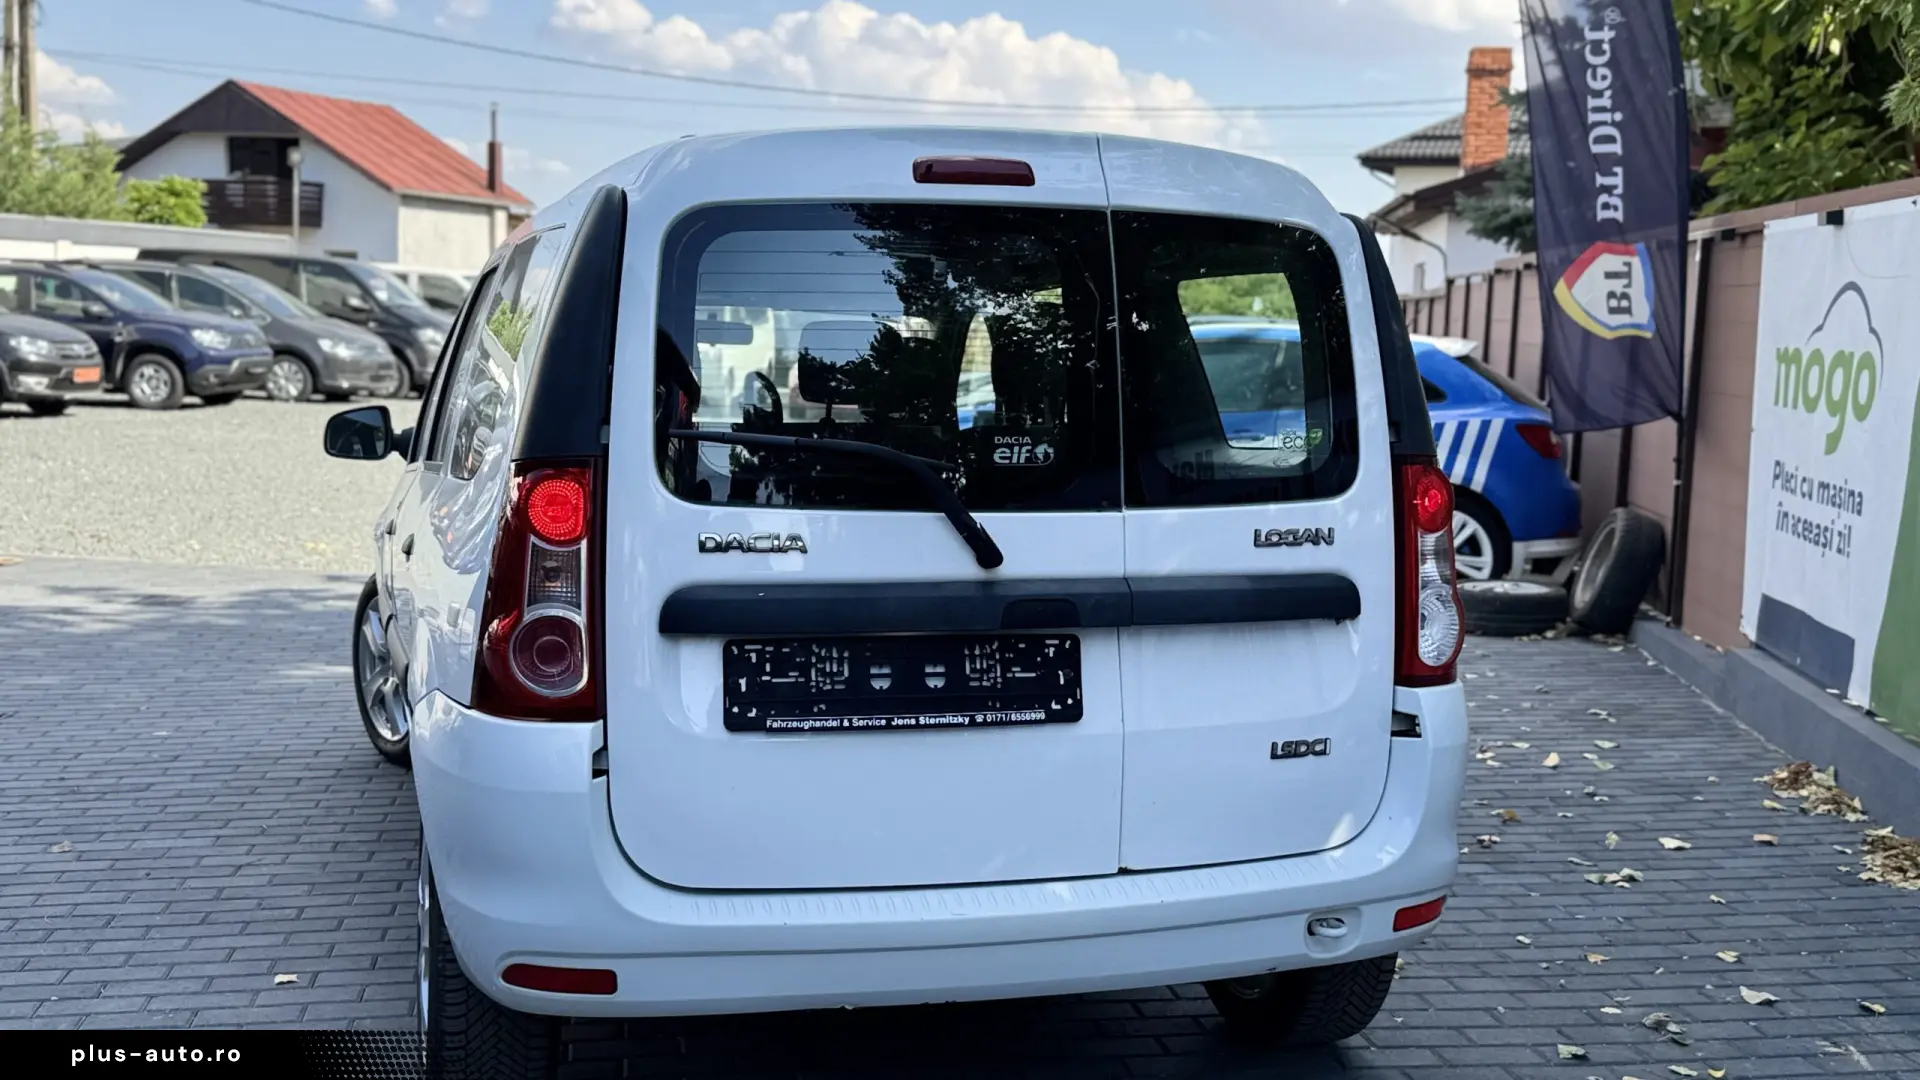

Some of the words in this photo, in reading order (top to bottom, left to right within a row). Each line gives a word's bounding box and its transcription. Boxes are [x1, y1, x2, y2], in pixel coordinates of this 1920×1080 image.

[1773, 346, 1877, 456] mogo
[994, 436, 1032, 444] DACIA
[993, 445, 1033, 464] elf
[1771, 459, 1799, 497] Pleci
[1800, 475, 1814, 502] cu
[1816, 478, 1864, 519] mașina
[1253, 527, 1335, 548] LOGAN
[1775, 500, 1790, 534] în
[1836, 524, 1852, 559] zi!
[698, 531, 808, 554] DACIA
[766, 718, 841, 729] Fahrzeughandel
[843, 718, 850, 727] &
[852, 717, 887, 727] Service
[891, 716, 917, 726] Jens
[918, 714, 970, 726] Sternitzky
